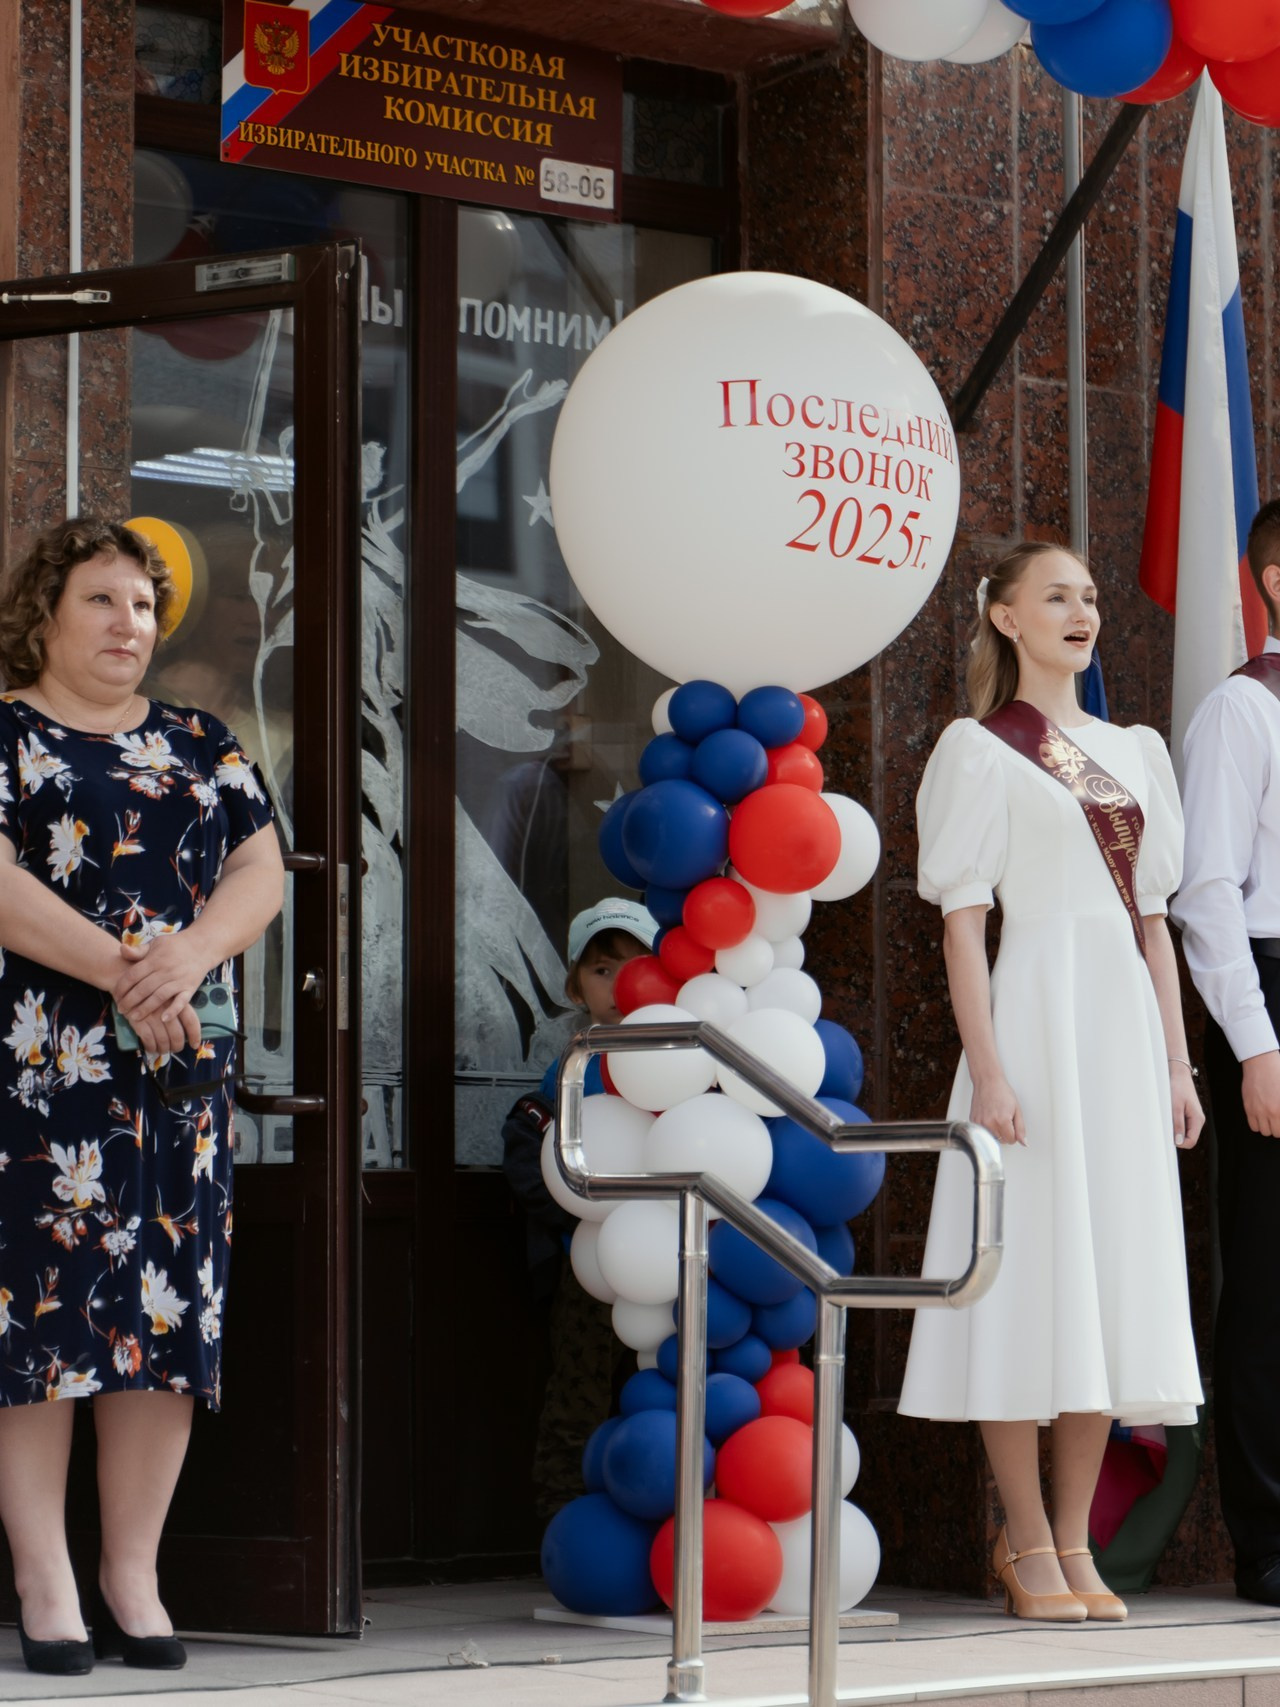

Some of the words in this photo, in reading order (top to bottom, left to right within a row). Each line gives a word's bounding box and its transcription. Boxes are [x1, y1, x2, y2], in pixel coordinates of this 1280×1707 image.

[371, 22, 567, 80] УЧАСТКОВАЯ
[338, 53, 597, 120] ИЗБИРАТЕЛЬНАЯ
[383, 95, 554, 147] КОМИССИЯ
[238, 120, 417, 168] ИЗБИРАТЕЛЬНОГО
[424, 150, 507, 183] УЧАСТКА
[514, 163, 535, 186] №
[542, 169, 606, 200] 58-06
[716, 378, 954, 465] Последний
[785, 489, 932, 570] 2025г.
[1092, 822, 1106, 847] КЛАСС
[1103, 847, 1116, 868] МАОУ
[1113, 869, 1124, 887] СОШ
